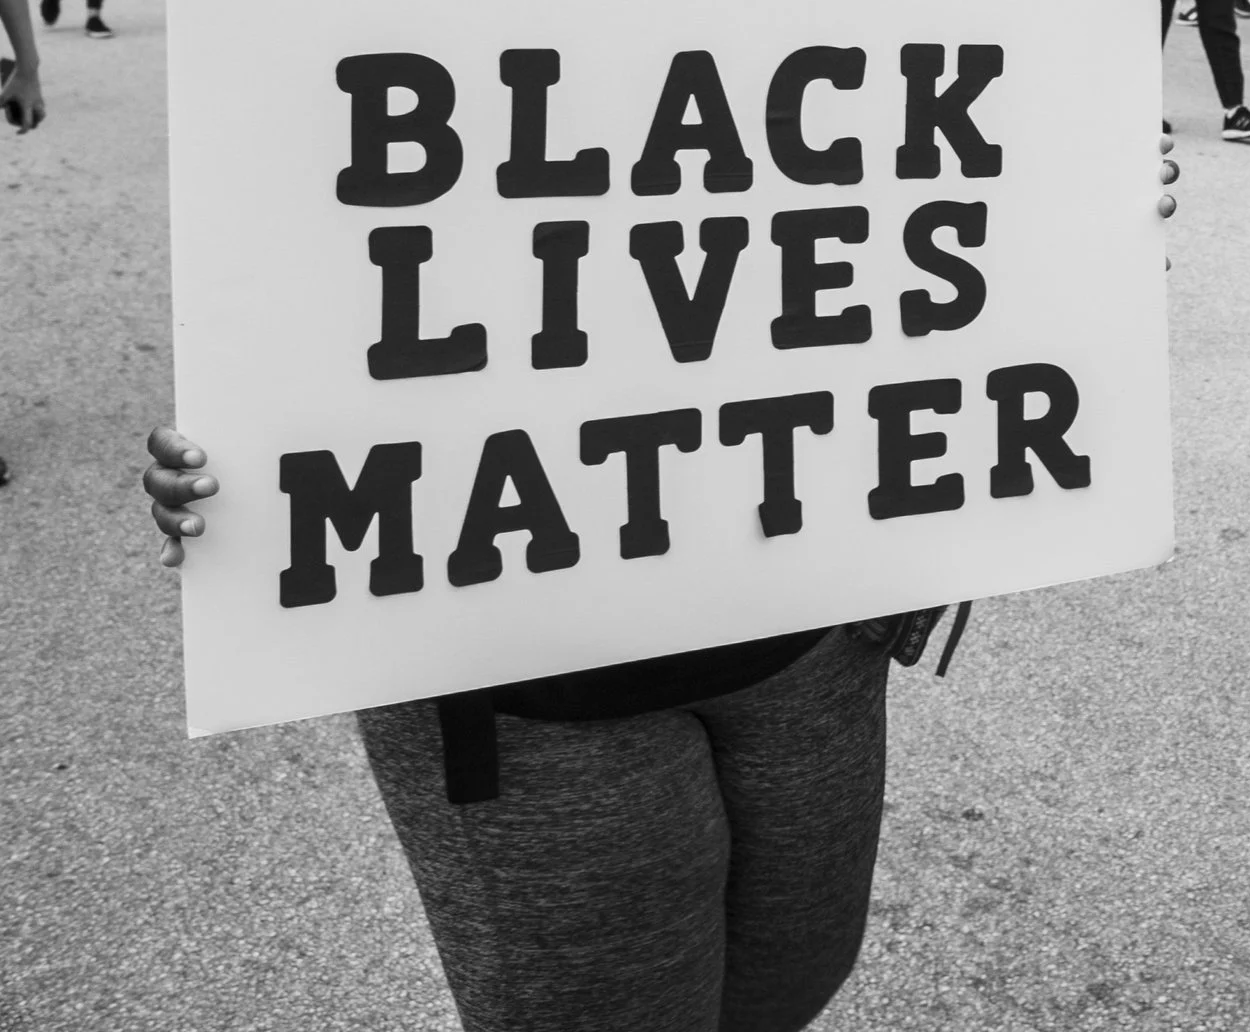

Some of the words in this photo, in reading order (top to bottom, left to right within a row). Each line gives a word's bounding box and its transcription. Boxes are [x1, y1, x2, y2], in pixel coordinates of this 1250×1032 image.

[336, 44, 1003, 207] BLACK
[367, 201, 987, 380] LIVES
[280, 363, 1091, 608] MATTER
